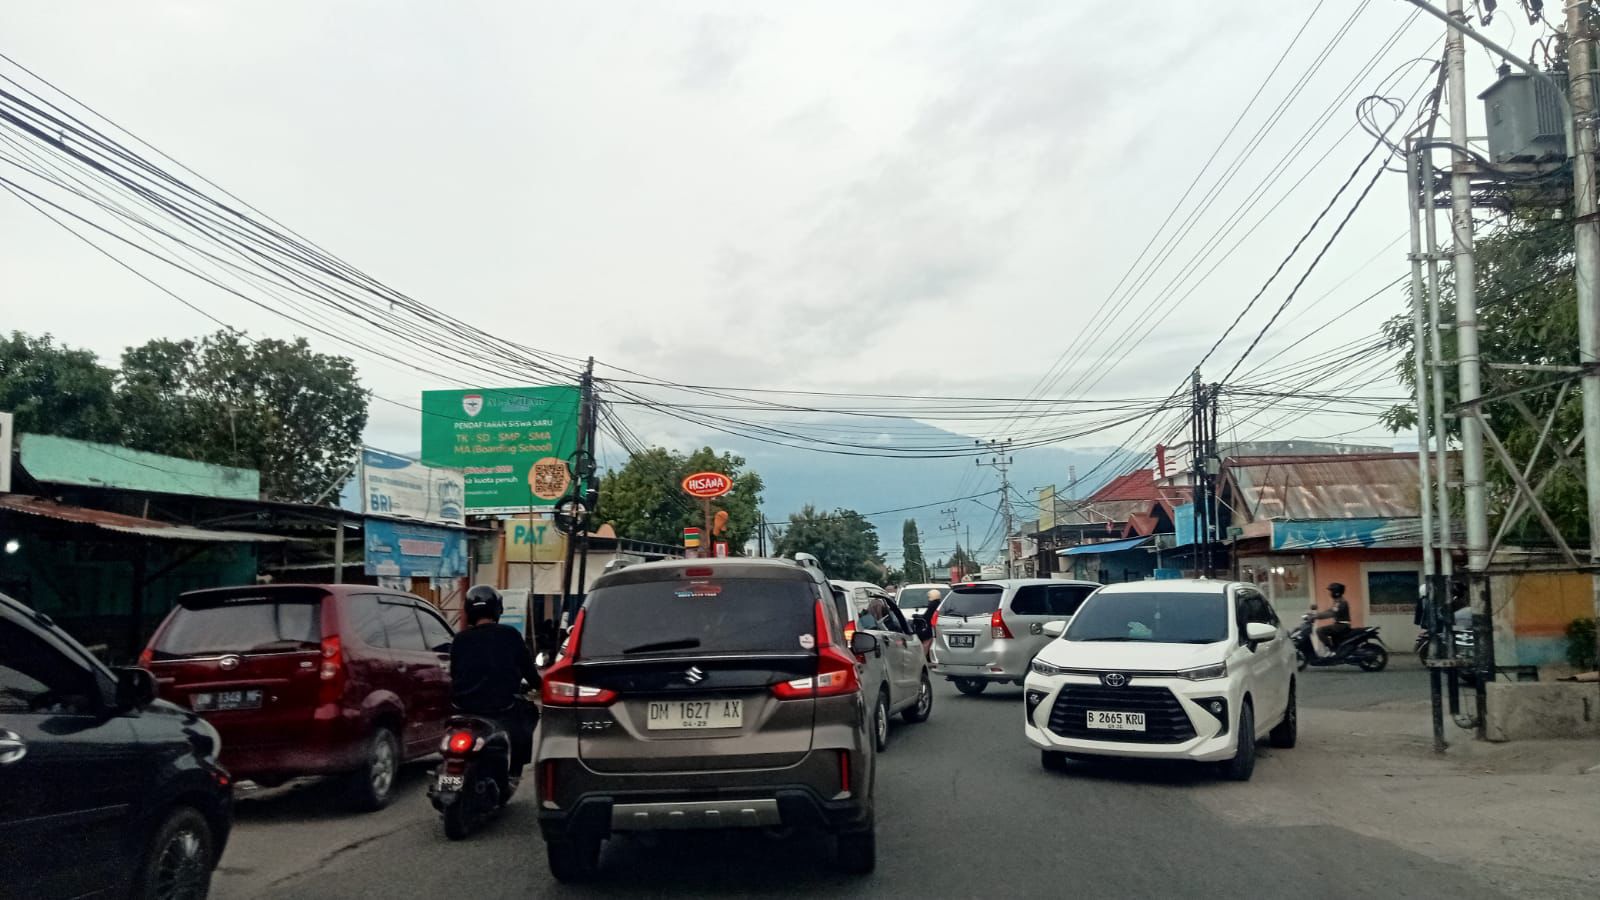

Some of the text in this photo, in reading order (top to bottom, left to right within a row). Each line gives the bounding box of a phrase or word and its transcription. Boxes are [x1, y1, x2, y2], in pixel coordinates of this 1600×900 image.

[454, 421, 508, 430] PENDAFTARAN
[508, 420, 532, 428] SISWA
[456, 431, 551, 443] TK SD SMP SMA
[472, 444, 516, 455] (Boarding
[519, 443, 553, 453] School)
[688, 478, 724, 489] HISANA
[370, 494, 392, 512] BRI
[514, 525, 547, 545] PAT
[650, 701, 740, 720] DM 1627 AX
[1088, 712, 1143, 724] B 2665 KRU
